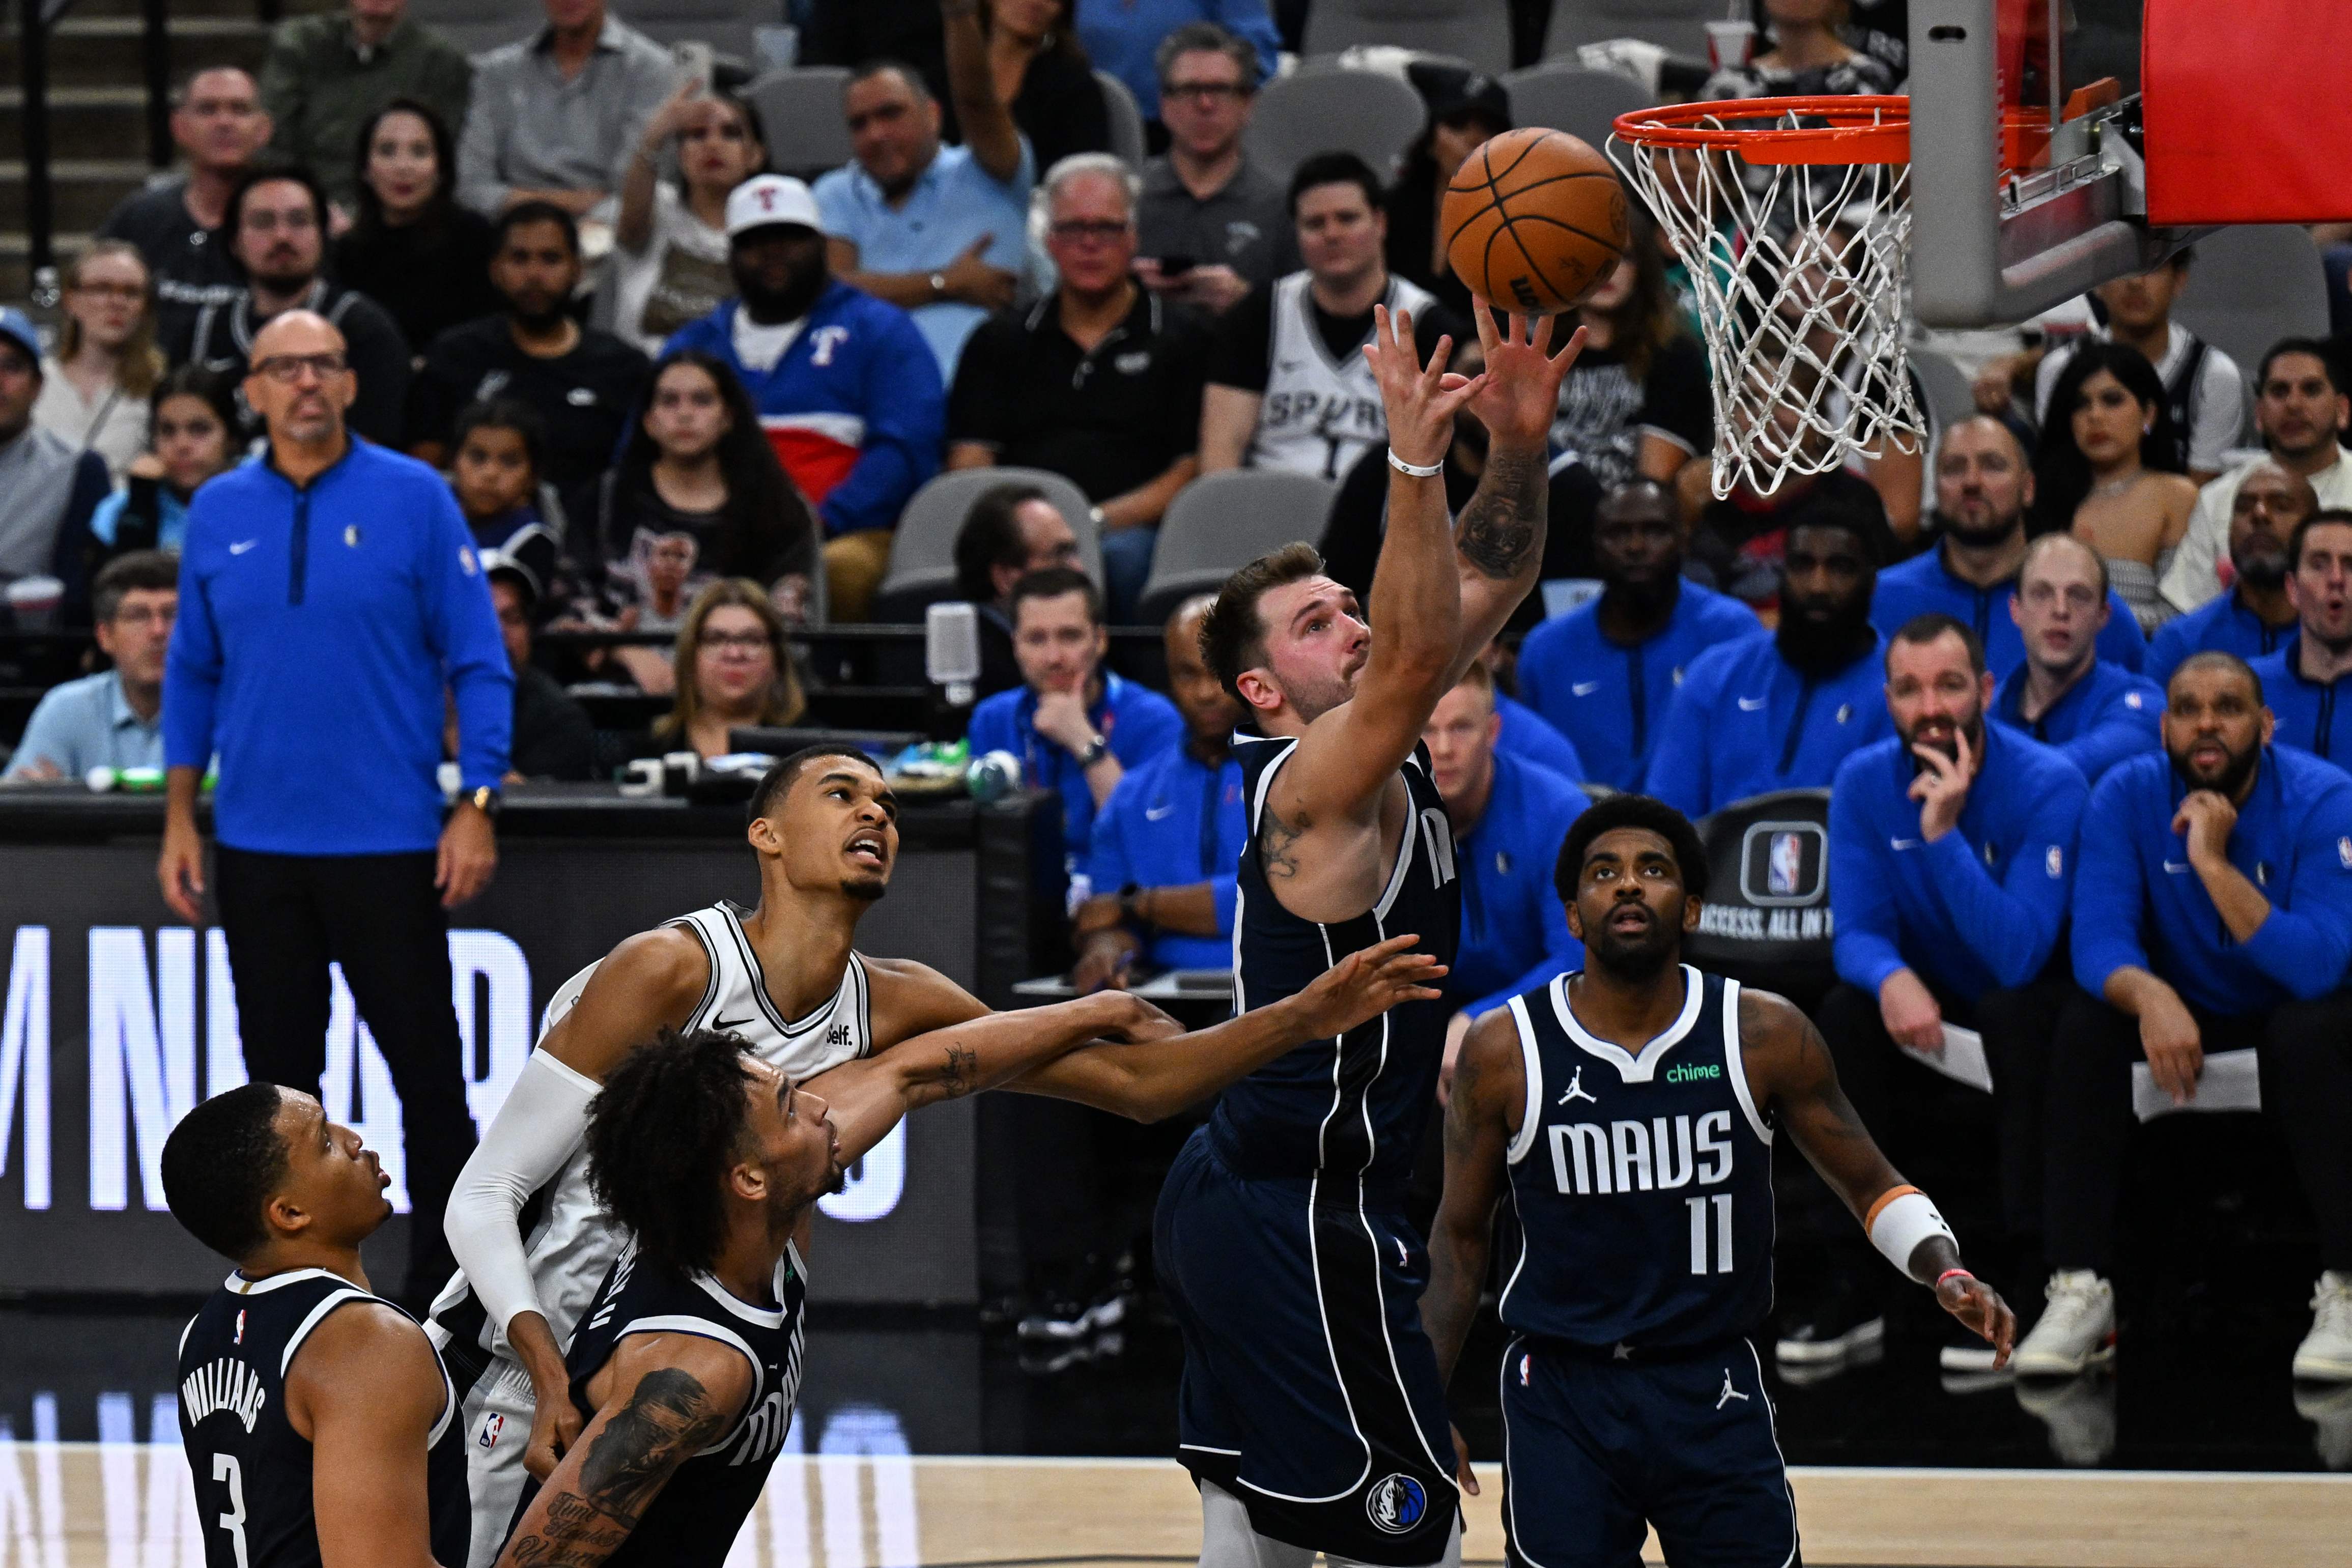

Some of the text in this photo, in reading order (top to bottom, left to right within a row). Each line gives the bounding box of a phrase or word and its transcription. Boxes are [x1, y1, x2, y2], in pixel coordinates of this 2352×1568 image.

[809, 325, 848, 366] T
[1269, 390, 1381, 431] SPUR
[1666, 1062, 1720, 1083] chime
[1548, 1109, 1733, 1195] MAVS
[1685, 1193, 1733, 1275] 11
[182, 1357, 266, 1434] WILLIAMS
[212, 1452, 249, 1568] 3
